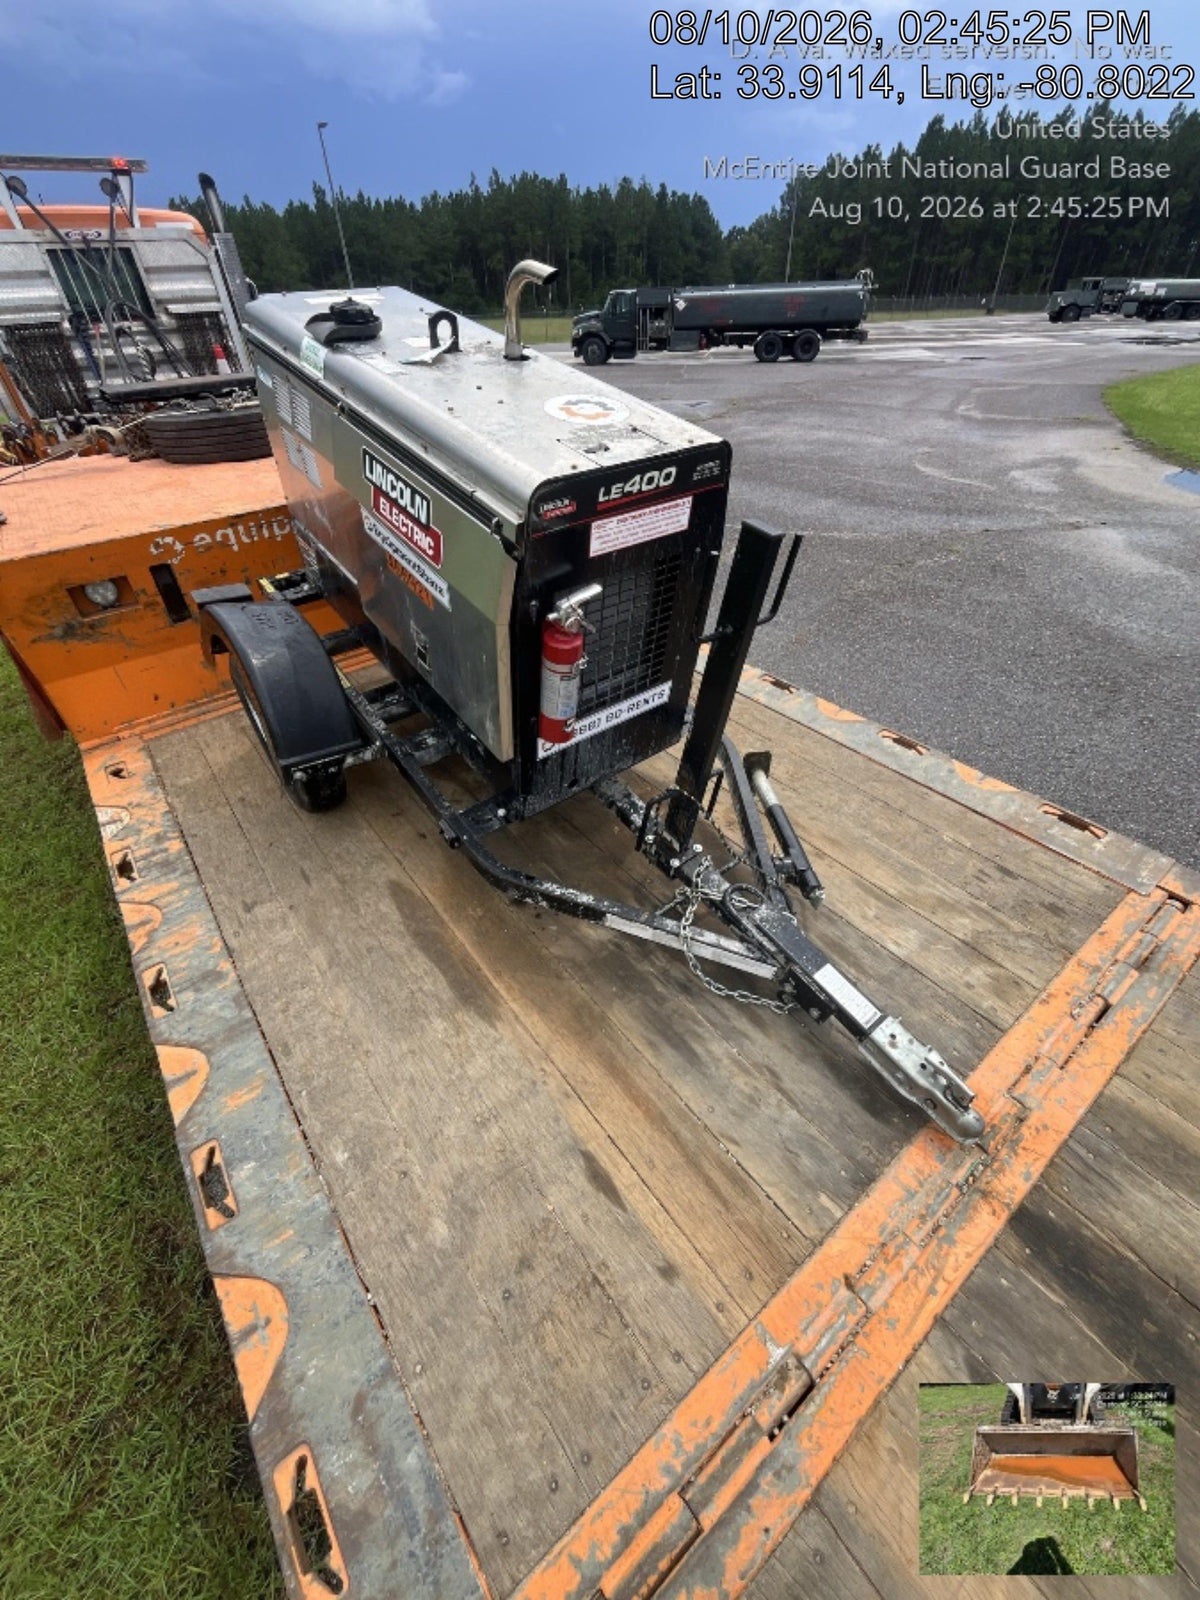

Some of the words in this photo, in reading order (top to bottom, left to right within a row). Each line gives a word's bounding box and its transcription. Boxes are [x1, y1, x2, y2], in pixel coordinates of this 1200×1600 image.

[365, 454, 428, 524] LINCOLN
[598, 466, 677, 502] LE400
[379, 496, 435, 556] ELECTRIC
